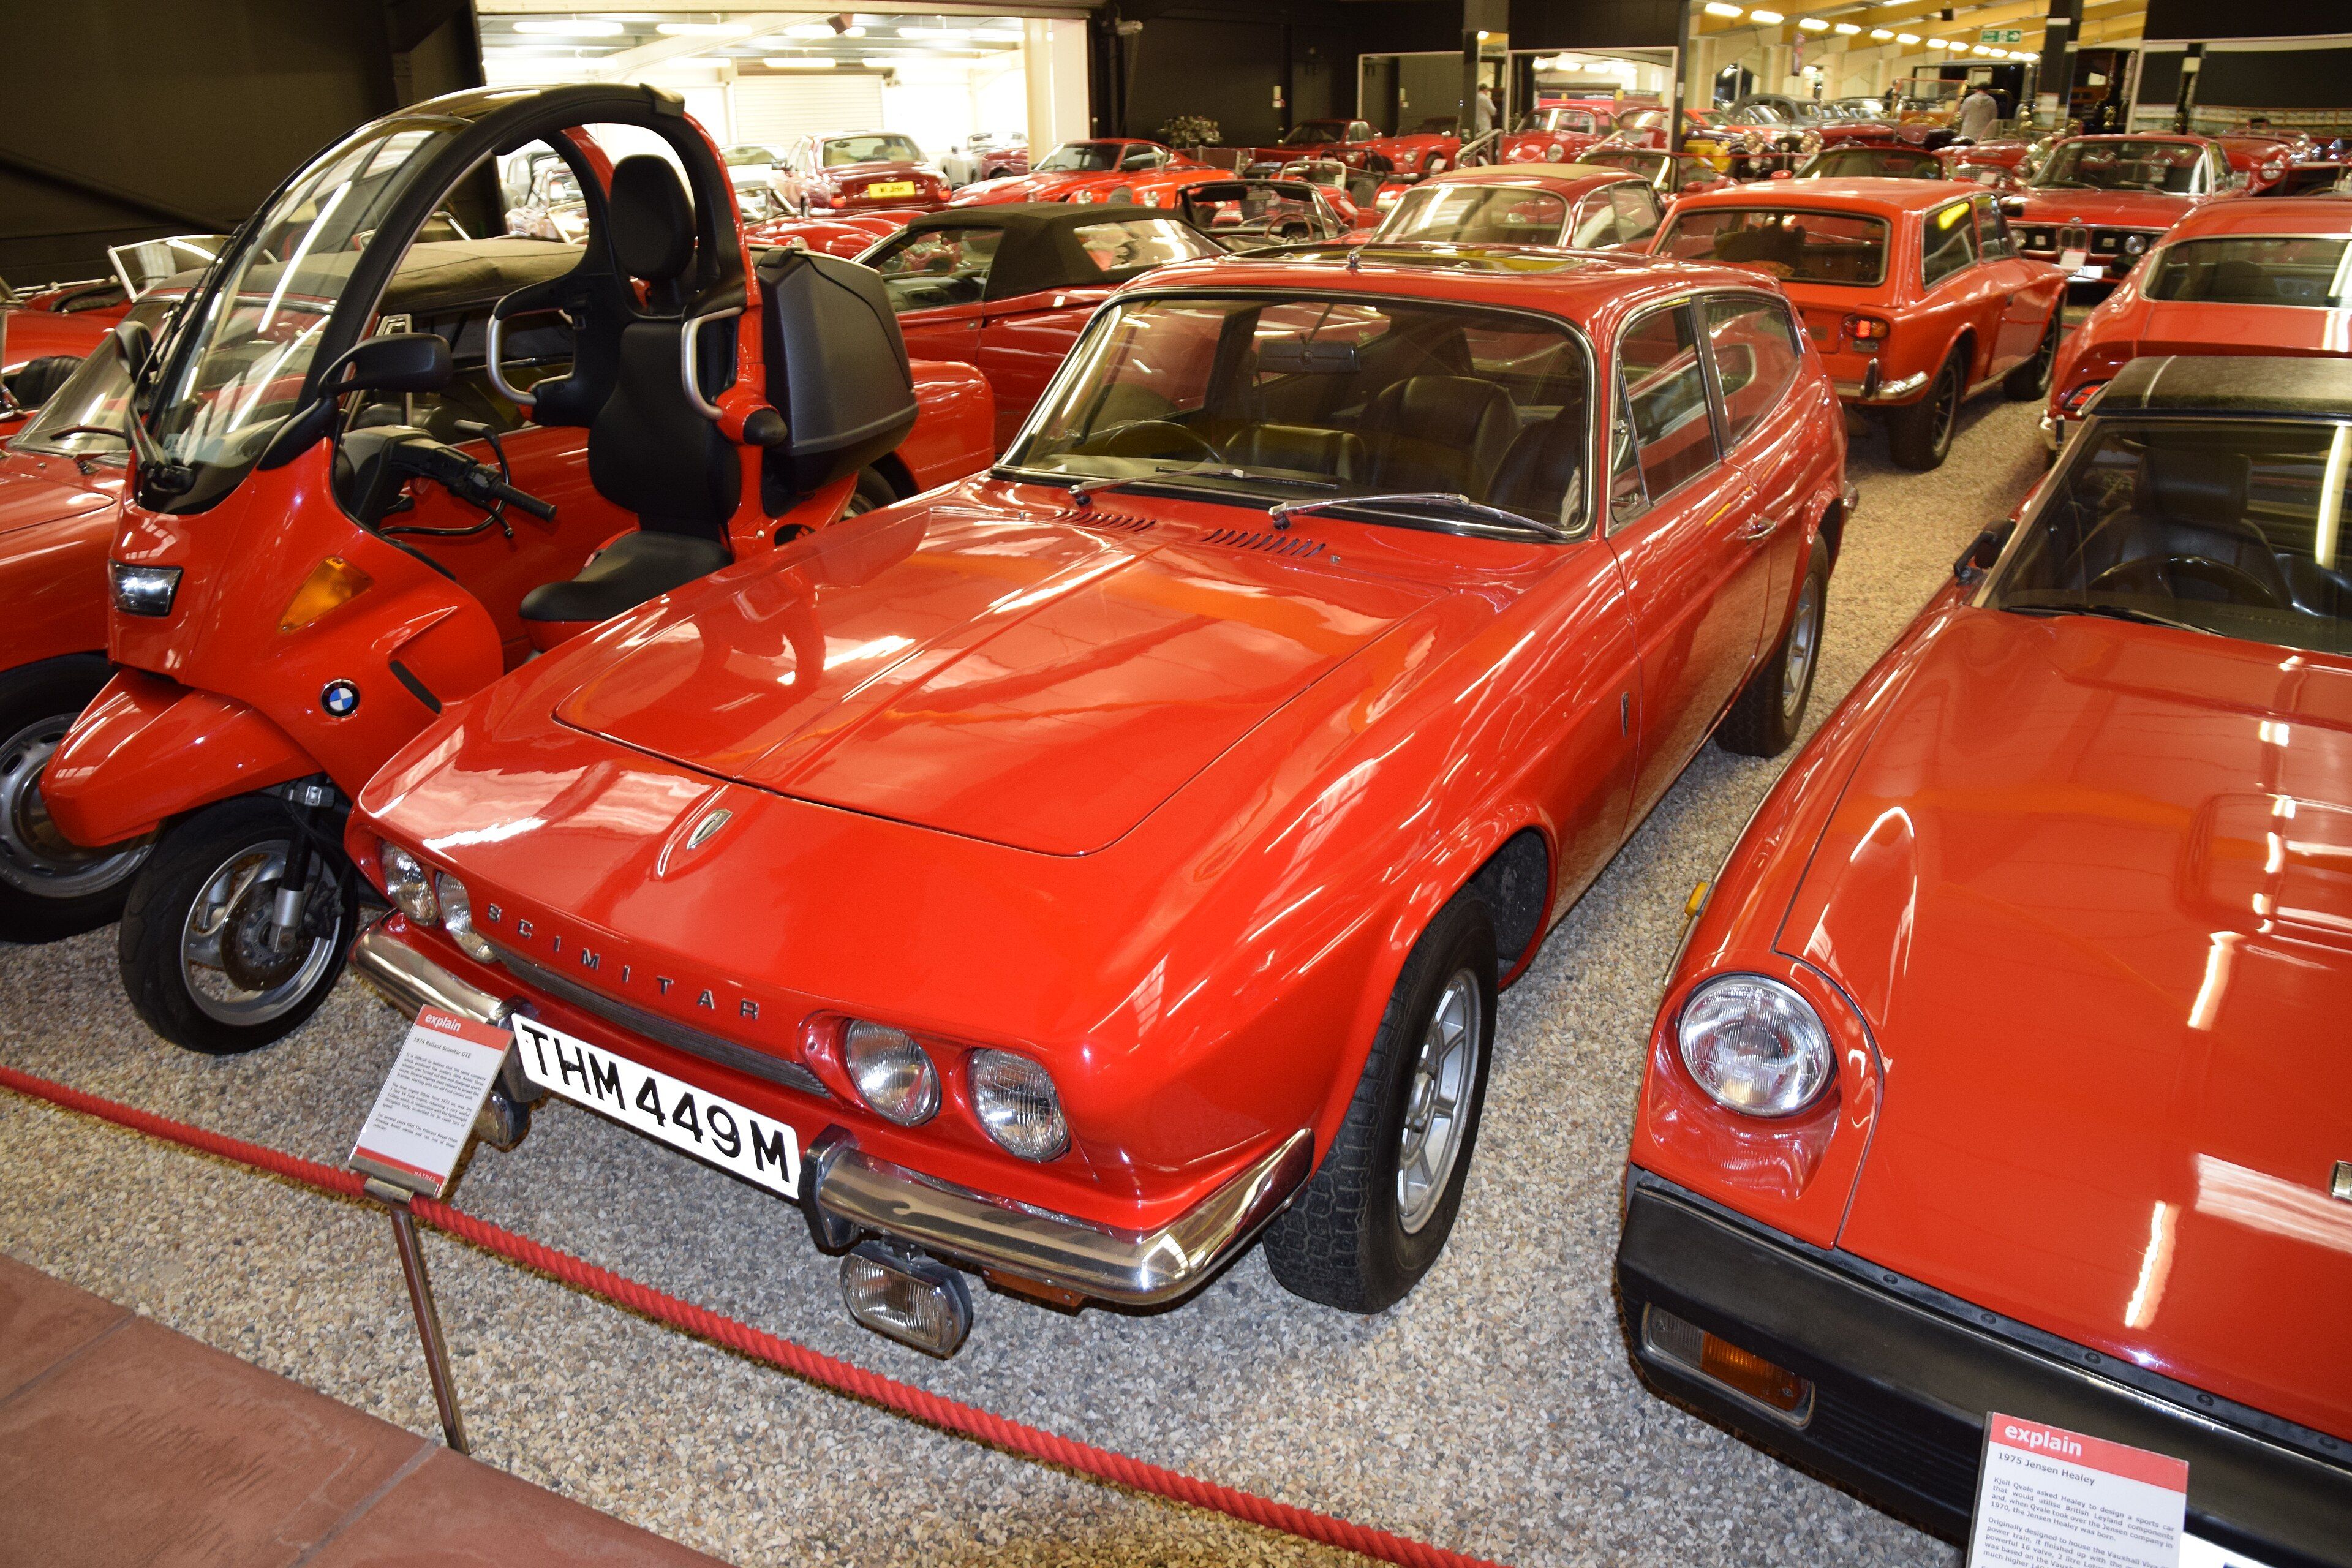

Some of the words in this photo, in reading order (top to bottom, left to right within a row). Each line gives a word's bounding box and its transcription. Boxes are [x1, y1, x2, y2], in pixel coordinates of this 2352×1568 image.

[487, 903, 761, 1020] SCIMITAR
[424, 1012, 462, 1032] explain
[425, 1040, 442, 1050] Reliant
[442, 1046, 461, 1055] Scimitar
[522, 1025, 625, 1112] THM
[413, 1169, 437, 1182] HAYNES
[2004, 1422, 2082, 1457] explain
[1999, 1452, 2022, 1464] 1975
[2025, 1459, 2059, 1474] Jensen
[2062, 1469, 2095, 1486] Healey
[1991, 1494, 2007, 1502] and,
[2009, 1499, 2029, 1508] when
[2030, 1504, 2051, 1514] Qvale
[2052, 1510, 2068, 1519] took
[2103, 1523, 2128, 1536] Jensen
[2130, 1532, 2164, 1547] company
[1992, 1485, 2008, 1494] that
[2012, 1491, 2034, 1501] would
[2038, 1499, 2061, 1509] utilise
[2065, 1505, 2089, 1517] British
[2094, 1513, 2123, 1526] Leyland
[2128, 1523, 2174, 1540] components
[1994, 1477, 2010, 1486] Kjell
[2013, 1482, 2034, 1493] Qvale
[2036, 1490, 2058, 1499] asked
[2060, 1496, 2086, 1508] Healey
[2100, 1507, 2124, 1518] design
[2136, 1517, 2159, 1528] sports
[1991, 1501, 2010, 1512] 1970,
[2013, 1507, 2025, 1515] the
[2026, 1511, 2051, 1523] Jensen
[2053, 1518, 2078, 1531] Healey
[2080, 1527, 2095, 1536] was
[2097, 1531, 2116, 1541] born.
[1983, 1550, 2003, 1560] much
[2005, 1556, 2028, 1567] higher
[1985, 1534, 2018, 1547] powerful
[2033, 1548, 2054, 1558] valve,
[2065, 1556, 2081, 1565] litre
[1985, 1542, 1999, 1550] was
[2001, 1545, 2023, 1557] based
[2036, 1556, 2048, 1564] the
[1986, 1526, 2009, 1536] power
[2013, 1532, 2032, 1544] train,
[2044, 1541, 2073, 1555] finished
[2089, 1555, 2106, 1564] with
[1988, 1517, 2023, 1532] Originally
[2024, 1528, 2057, 1541] designed
[2068, 1539, 2091, 1551] house
[2092, 1547, 2105, 1555] the
[2107, 1550, 2140, 1564] Vauxhall
